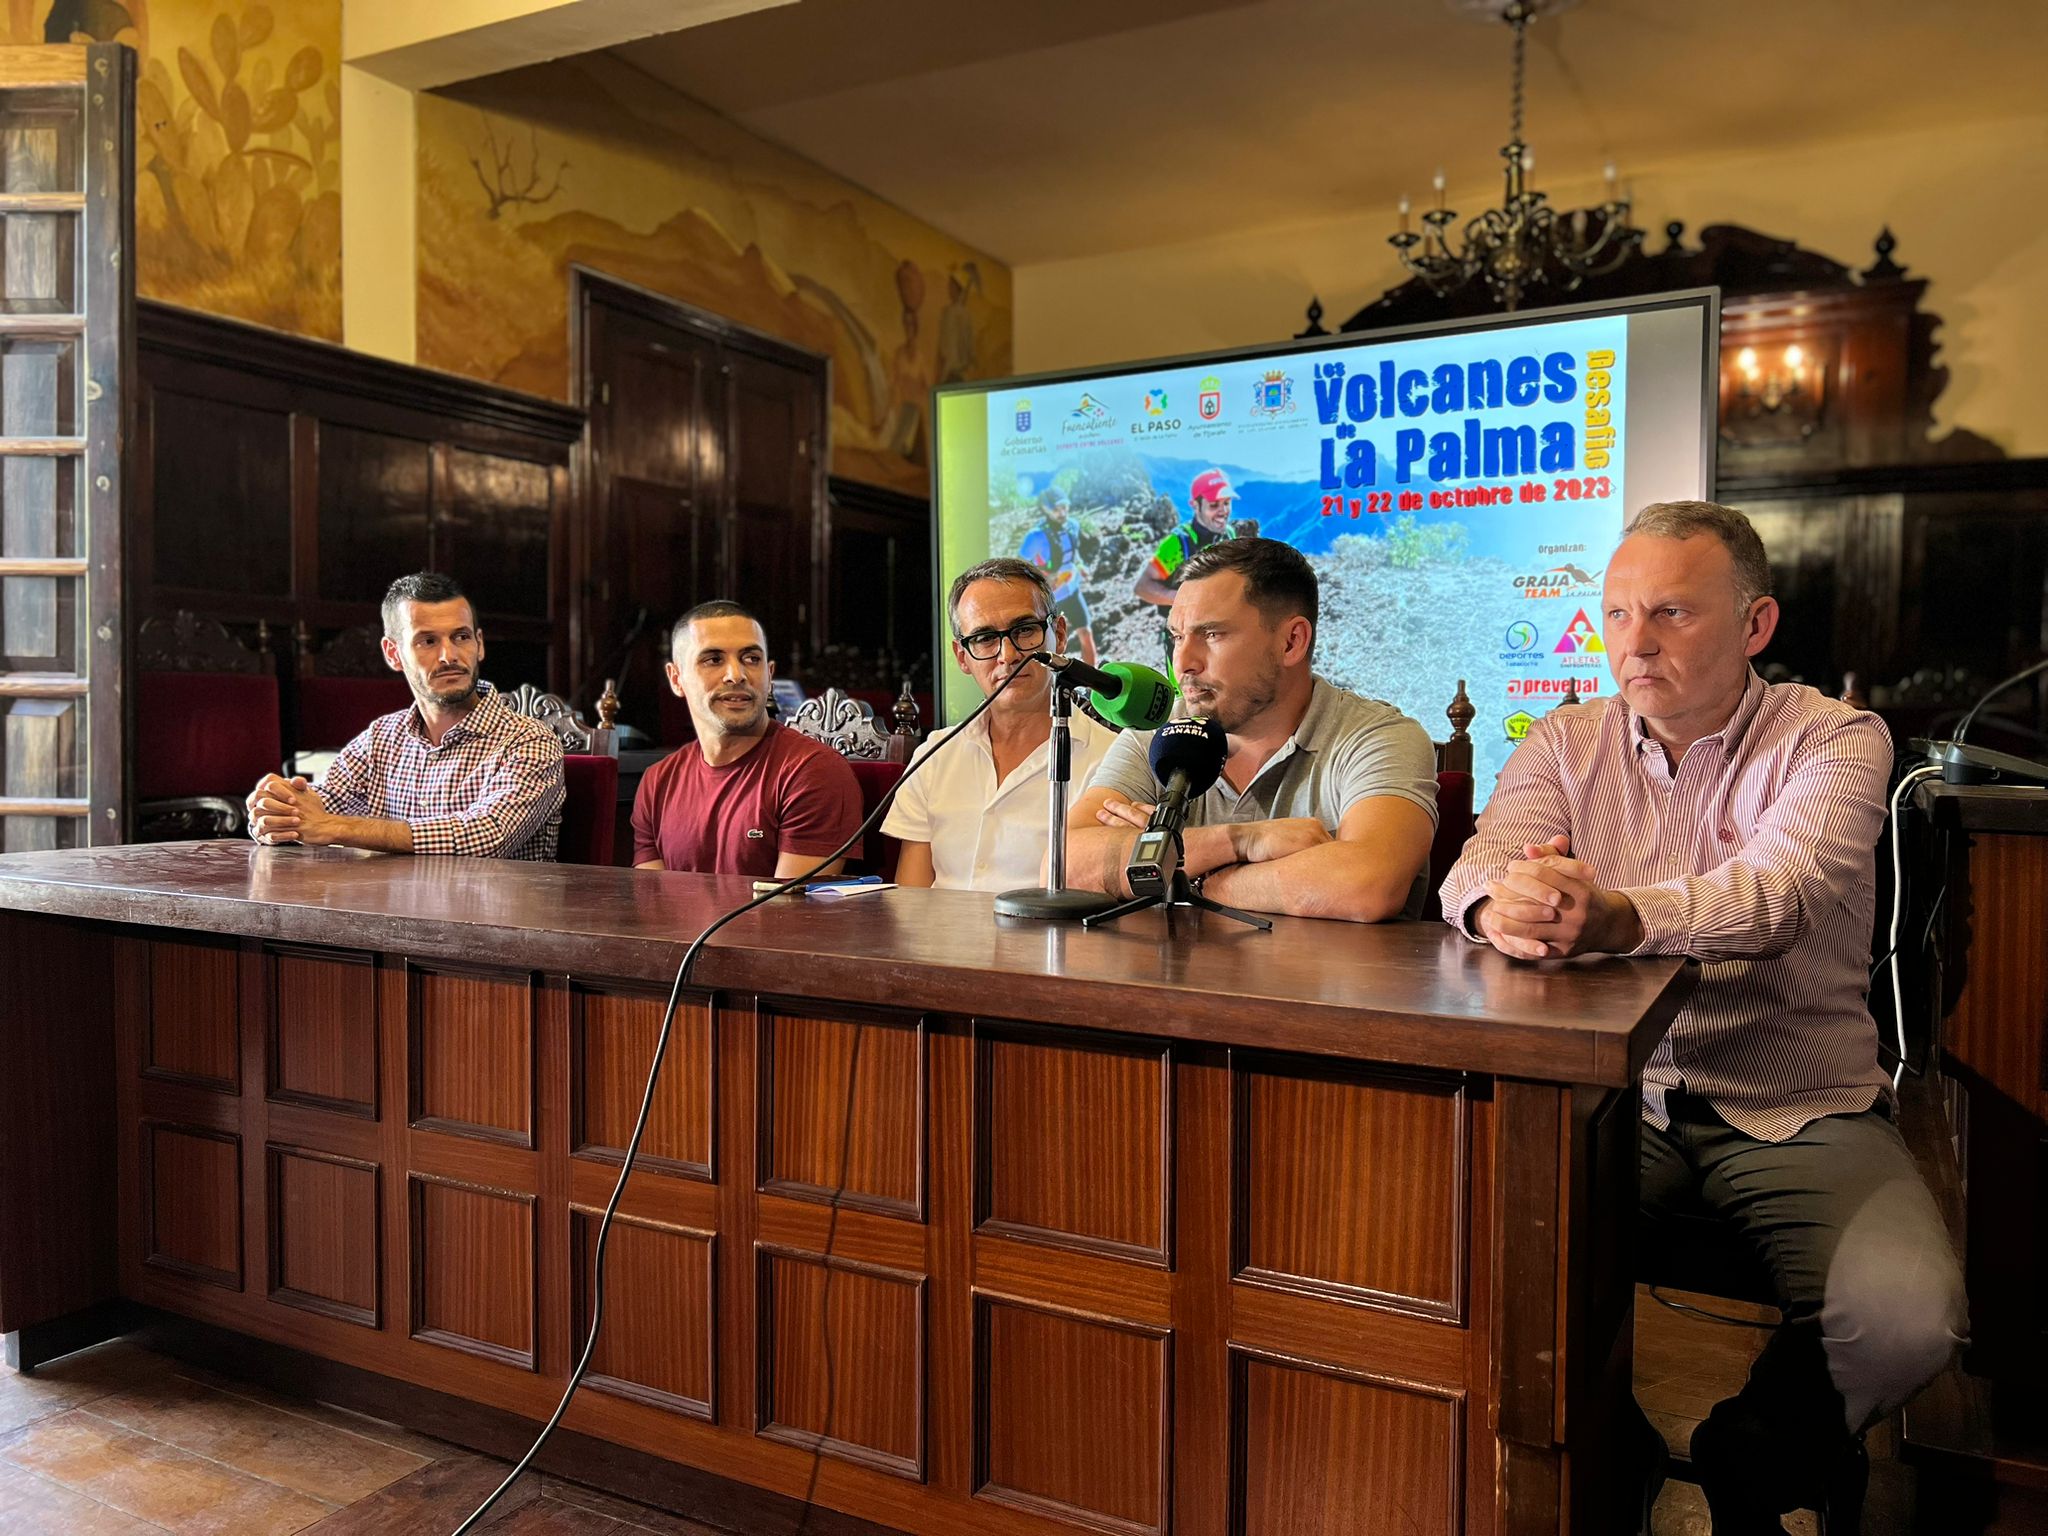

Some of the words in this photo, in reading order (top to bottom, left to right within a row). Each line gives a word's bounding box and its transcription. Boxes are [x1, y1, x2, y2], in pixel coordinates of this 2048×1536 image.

[1312, 351, 1578, 425] Volcanes
[1131, 423, 1144, 434] EL
[1148, 418, 1182, 432] PASO
[1320, 437, 1376, 490] La
[1395, 418, 1576, 484] Palma
[1321, 495, 1344, 516] 21
[1350, 500, 1361, 518] y
[1367, 491, 1393, 513] 22
[1399, 489, 1424, 512] de
[1430, 483, 1513, 509] octubre
[1519, 481, 1547, 503] de
[1553, 475, 1611, 501] 2023
[1512, 574, 1570, 588] GRAJA
[1524, 587, 1561, 599] TEAM
[1562, 656, 1601, 664] ATLETAS
[1161, 727, 1209, 739] CANARIA
